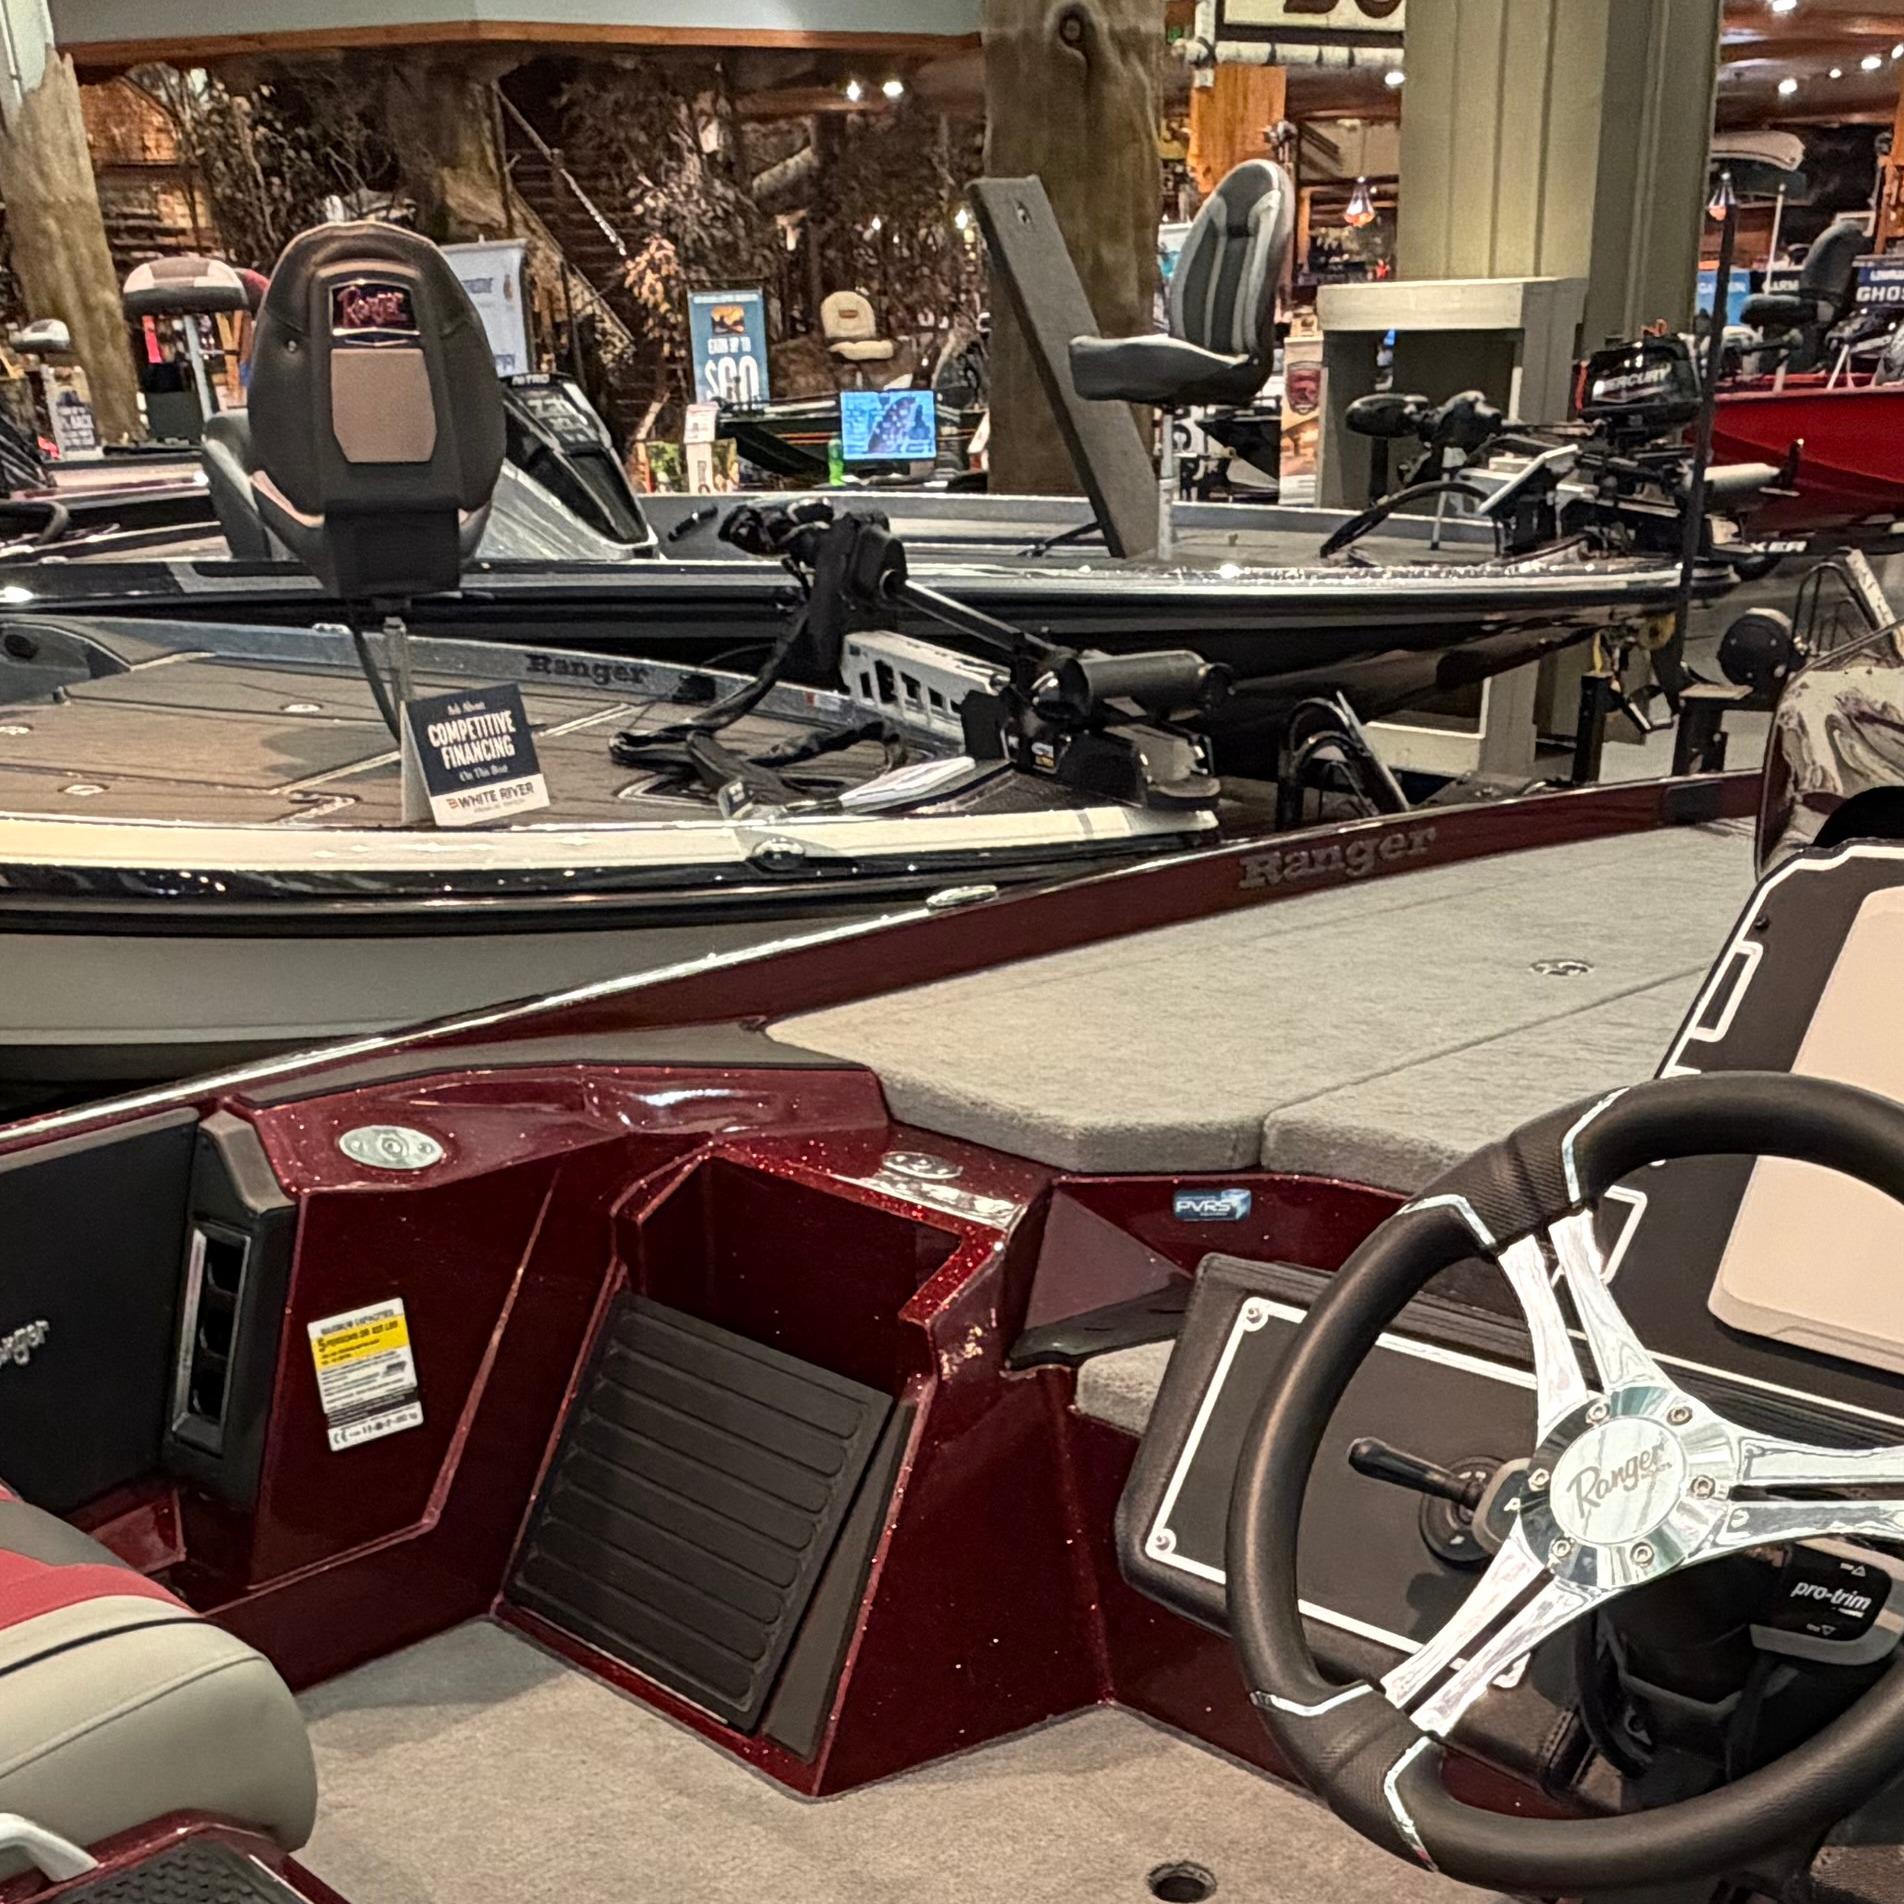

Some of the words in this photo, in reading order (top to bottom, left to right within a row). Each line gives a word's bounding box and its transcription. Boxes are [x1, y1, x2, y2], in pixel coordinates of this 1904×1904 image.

[526, 654, 649, 685] Ranger
[427, 710, 516, 748] COMPETITIVE
[441, 734, 516, 770] FINANCING
[457, 790, 497, 808] WHITE
[498, 782, 534, 800] RIVER
[1238, 826, 1437, 889] Ranger
[1565, 1430, 1666, 1519] Ranger
[1789, 1581, 1872, 1611] pro-trim
